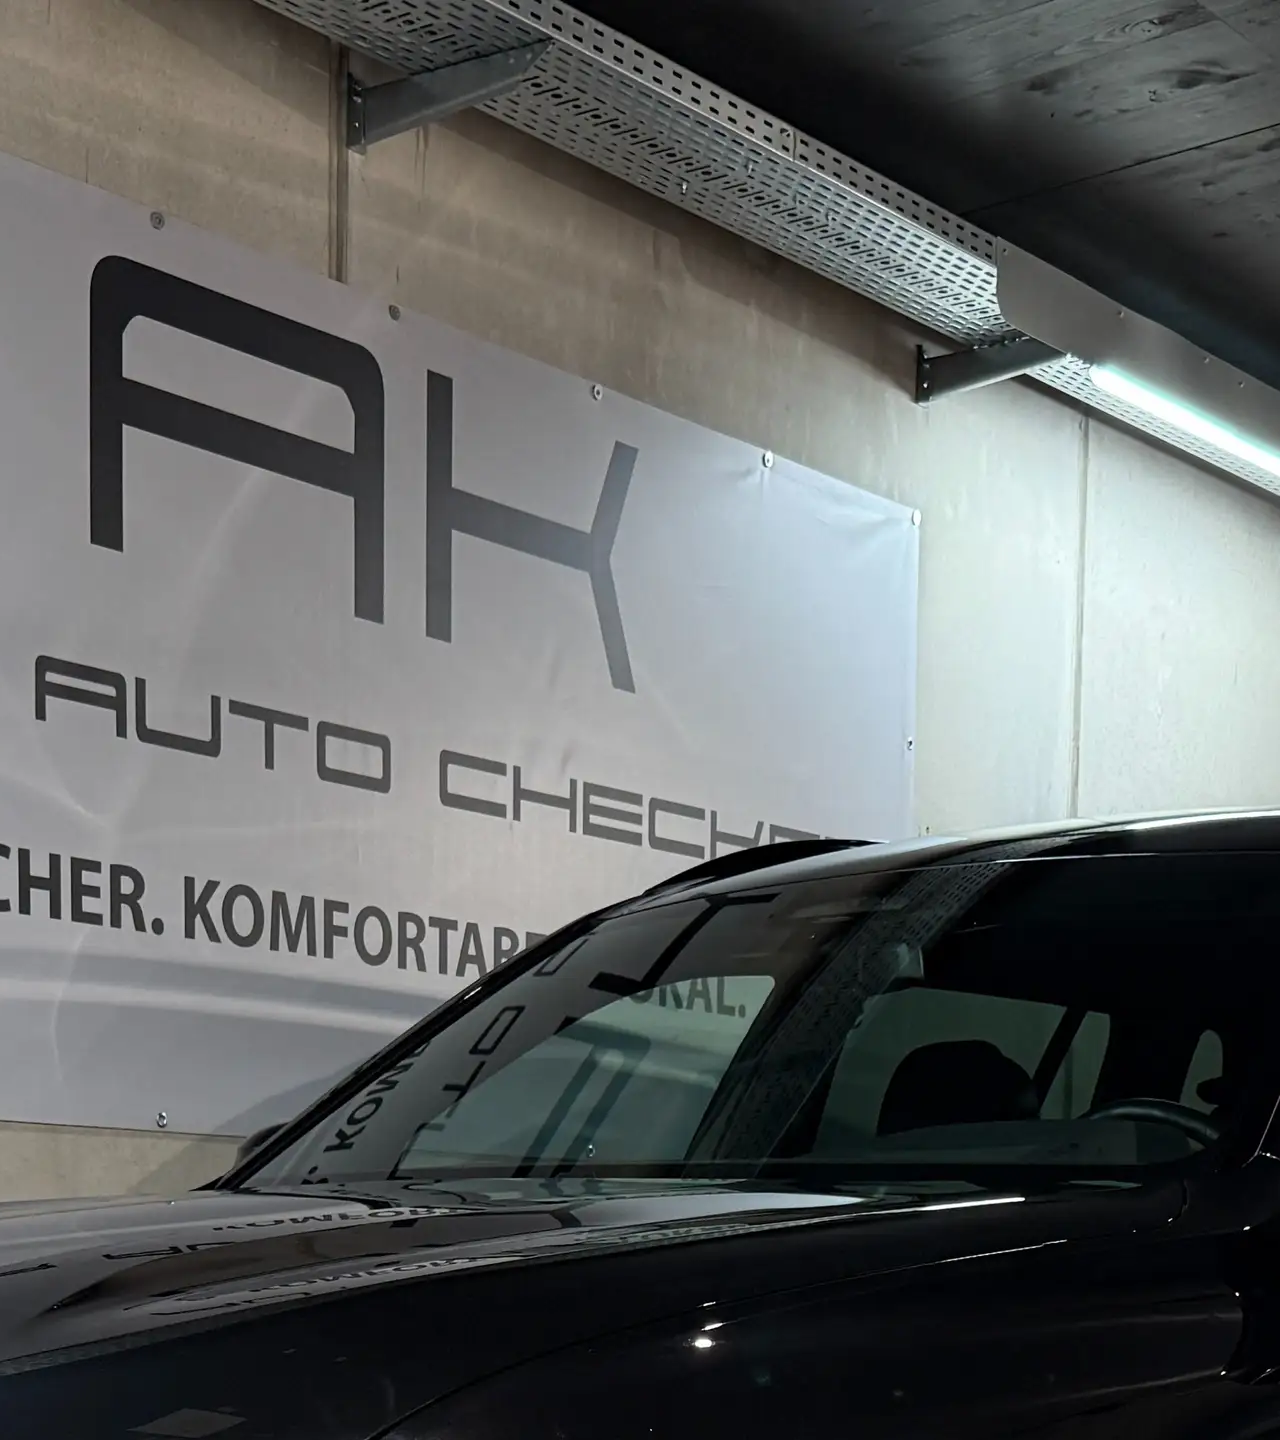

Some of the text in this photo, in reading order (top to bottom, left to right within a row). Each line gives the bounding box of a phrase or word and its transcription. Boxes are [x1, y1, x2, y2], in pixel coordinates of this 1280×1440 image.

[89, 255, 638, 694] AK
[34, 654, 392, 794] AUTO
[439, 749, 838, 860] CHECK
[183, 875, 550, 981] KOMFORTAB
